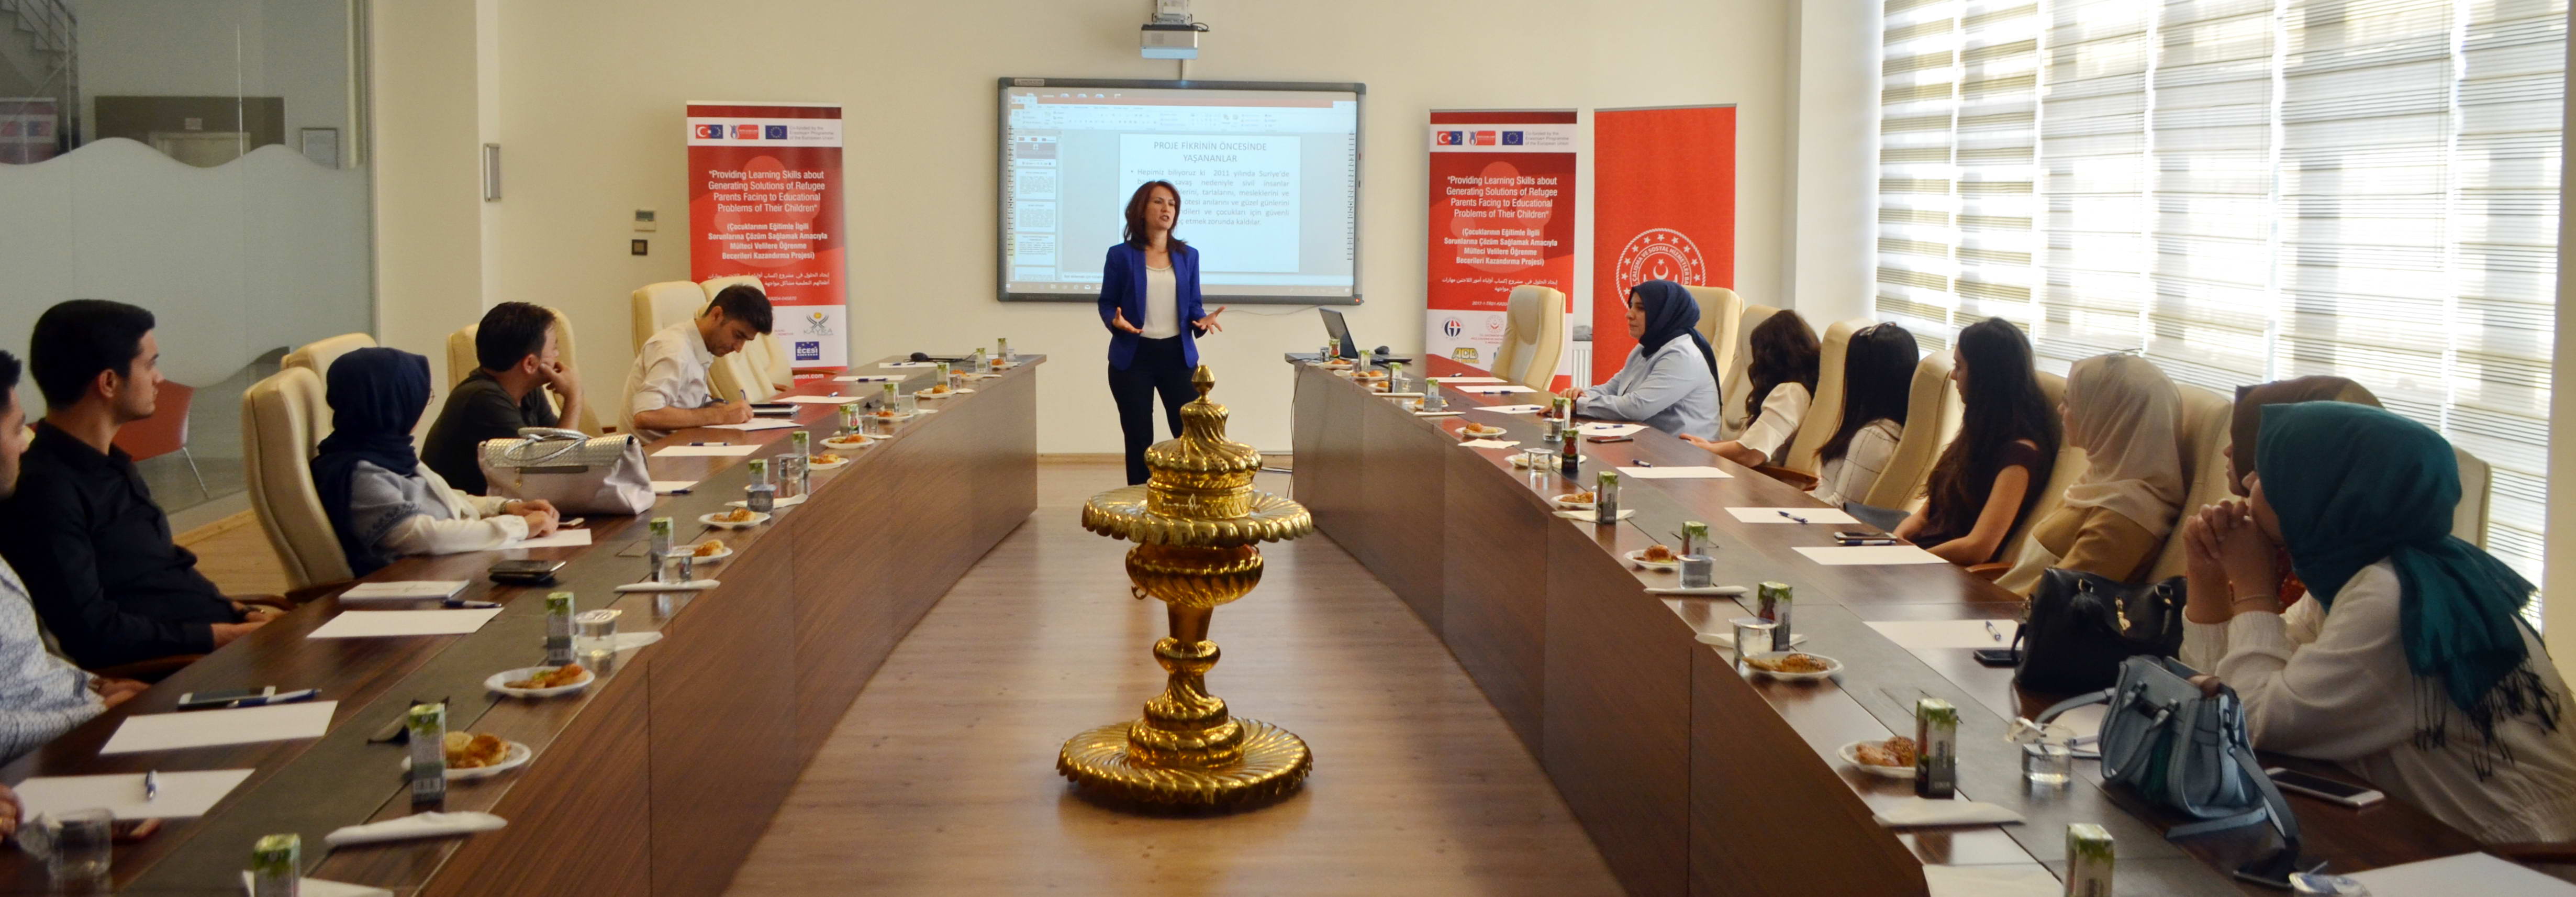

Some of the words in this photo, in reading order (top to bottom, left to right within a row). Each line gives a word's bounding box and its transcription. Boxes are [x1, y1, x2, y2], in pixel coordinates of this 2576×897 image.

[1181, 141, 1217, 150] FİKRİNİN
[1220, 141, 1267, 151] ÖNCESİNDE
[1183, 154, 1237, 163] YAŞANANLAR
[709, 171, 746, 180] "Providing
[749, 171, 780, 180] Learning
[804, 171, 824, 179] about
[1447, 176, 1482, 186] "Providing
[1485, 176, 1514, 186] Learning
[1516, 176, 1535, 185] Skills
[1537, 176, 1557, 185] about
[708, 182, 748, 191] Generating
[796, 182, 825, 191] Refugee
[1446, 187, 1484, 197] Generating
[1486, 187, 1518, 195] Solutions
[1529, 187, 1557, 197] Refugee
[713, 193, 741, 201] Parents
[743, 193, 767, 202] Facing
[779, 193, 821, 201] Educational
[1451, 198, 1477, 206] Parents
[1479, 198, 1501, 208] Facing
[1512, 198, 1553, 207] Educational
[1518, 209, 1549, 218] Children"
[1670, 248, 1689, 276] HİZMETLER
